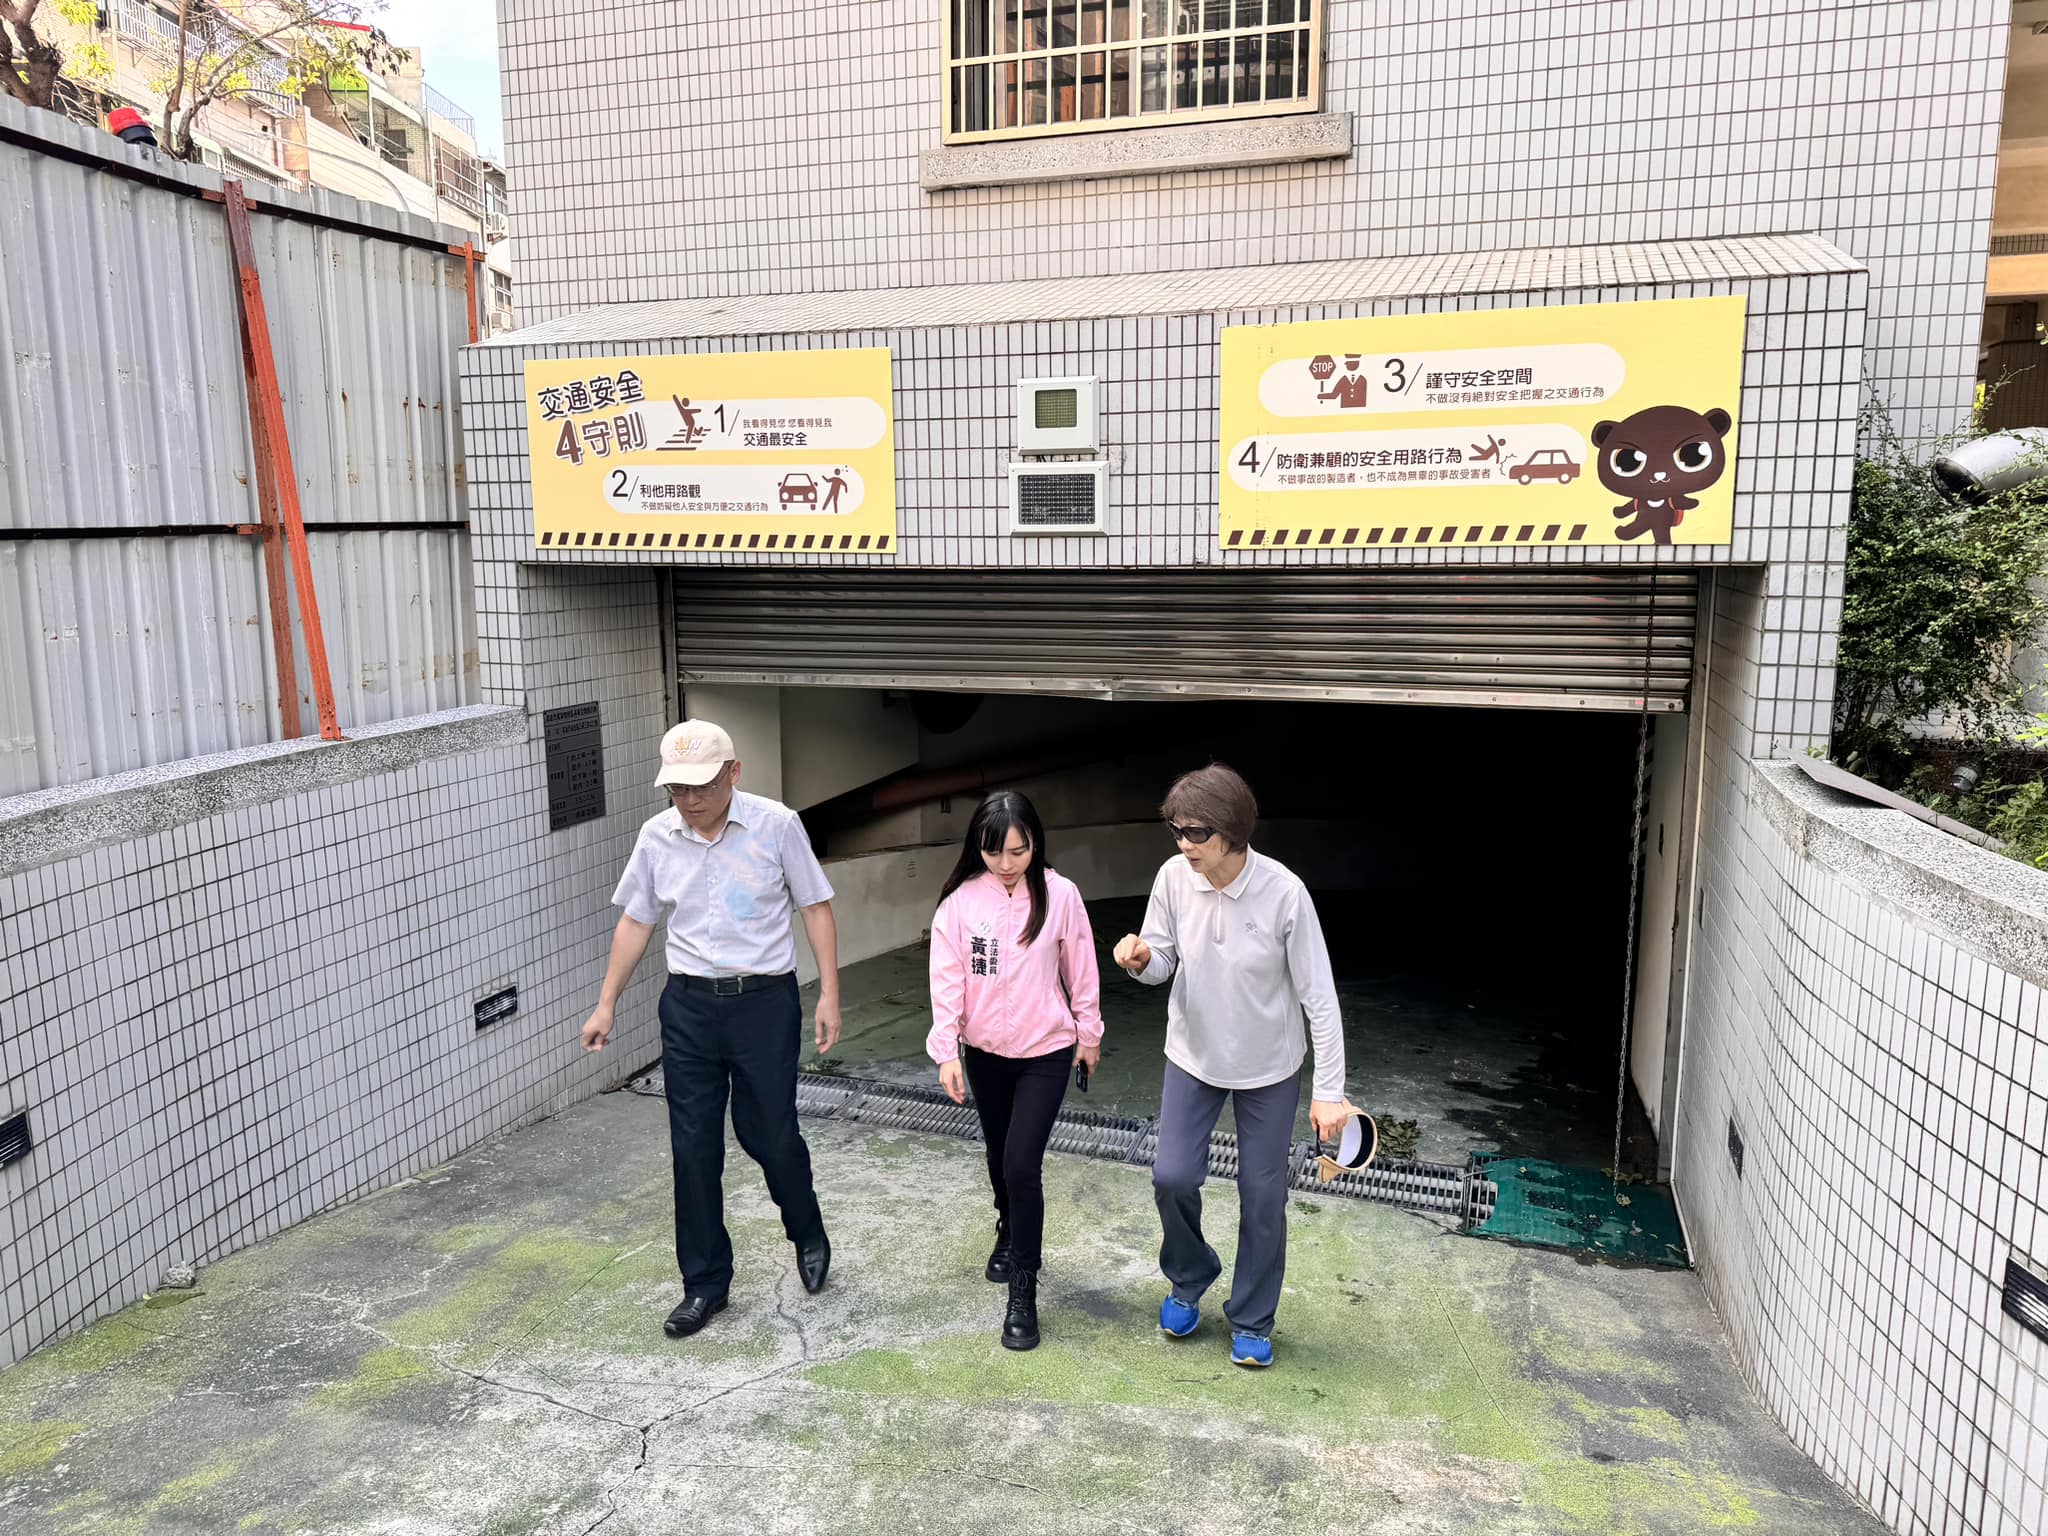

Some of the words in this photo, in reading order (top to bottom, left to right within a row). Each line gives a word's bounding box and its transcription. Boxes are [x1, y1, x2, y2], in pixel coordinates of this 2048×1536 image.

[1311, 361, 1334, 374] STOP
[1426, 367, 1533, 389] 謹守安全空間
[536, 369, 645, 421] 交通安全
[1425, 386, 1605, 405] 不做沒有絕對安全把握之交通行為
[555, 411, 648, 464] 4守則
[743, 431, 808, 447] 交通最安全
[1276, 447, 1462, 470] 防衛兼顧的安全用路行為
[640, 484, 701, 499] 利他用路觀
[971, 936, 987, 976] 黃捷
[990, 938, 999, 975] 立法委員
